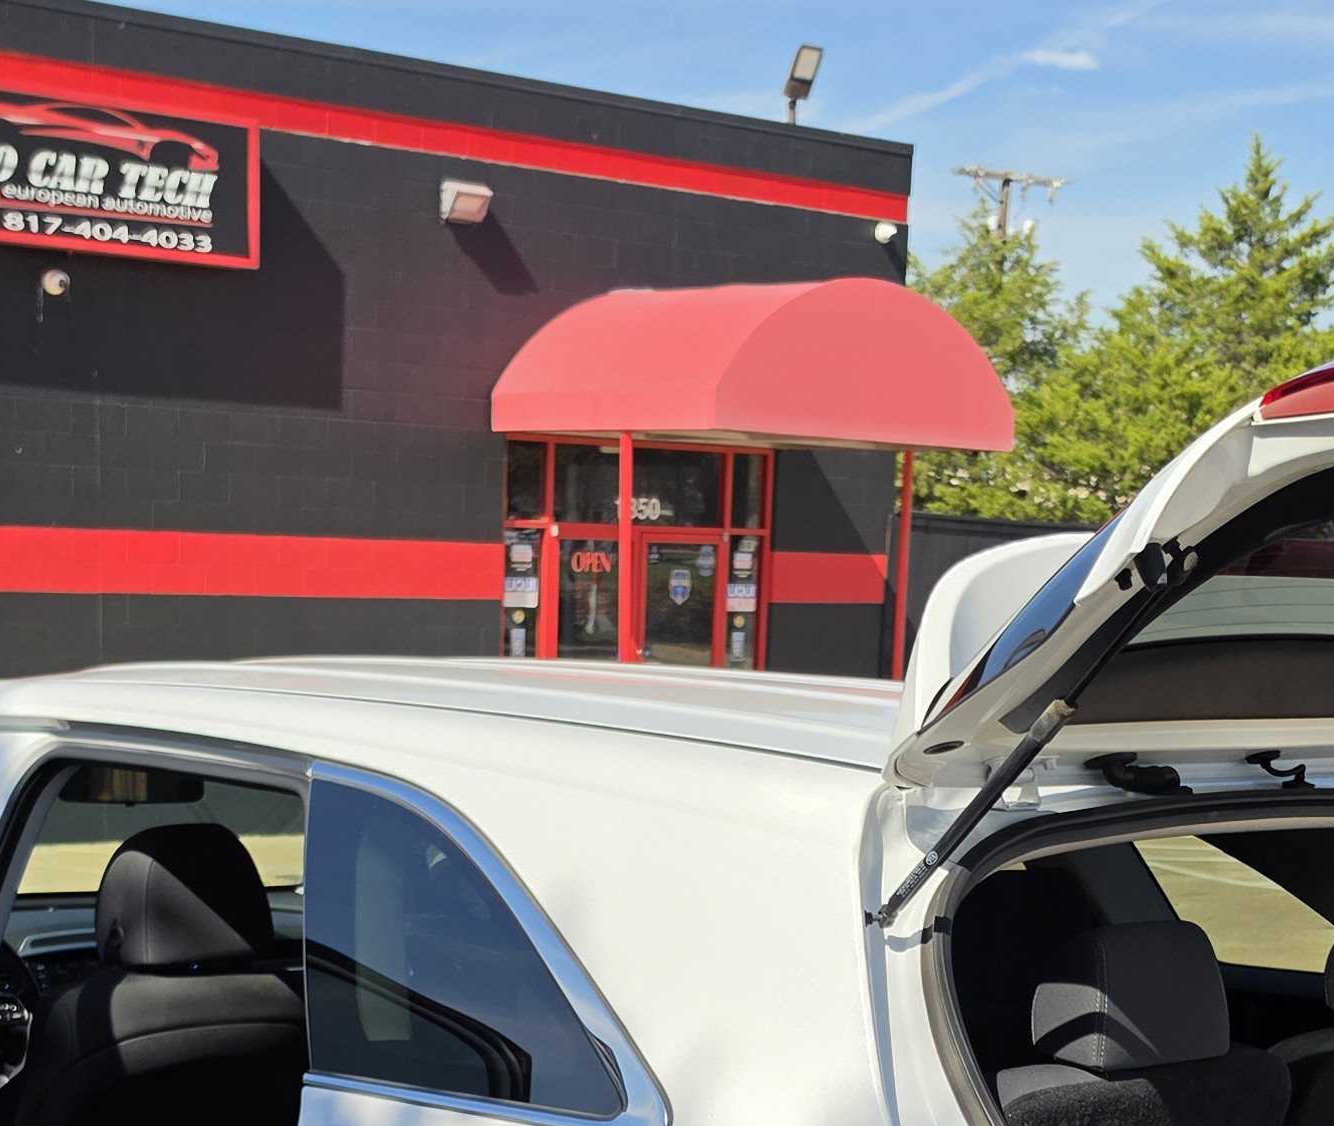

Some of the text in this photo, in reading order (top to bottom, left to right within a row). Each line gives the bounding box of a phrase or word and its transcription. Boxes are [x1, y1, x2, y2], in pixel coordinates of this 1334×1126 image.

[27, 151, 110, 195] CAR
[118, 162, 218, 208] TECH
[1, 183, 213, 223] european automotive
[2, 211, 212, 253] 817-404-4033
[571, 551, 612, 573] OPEN
